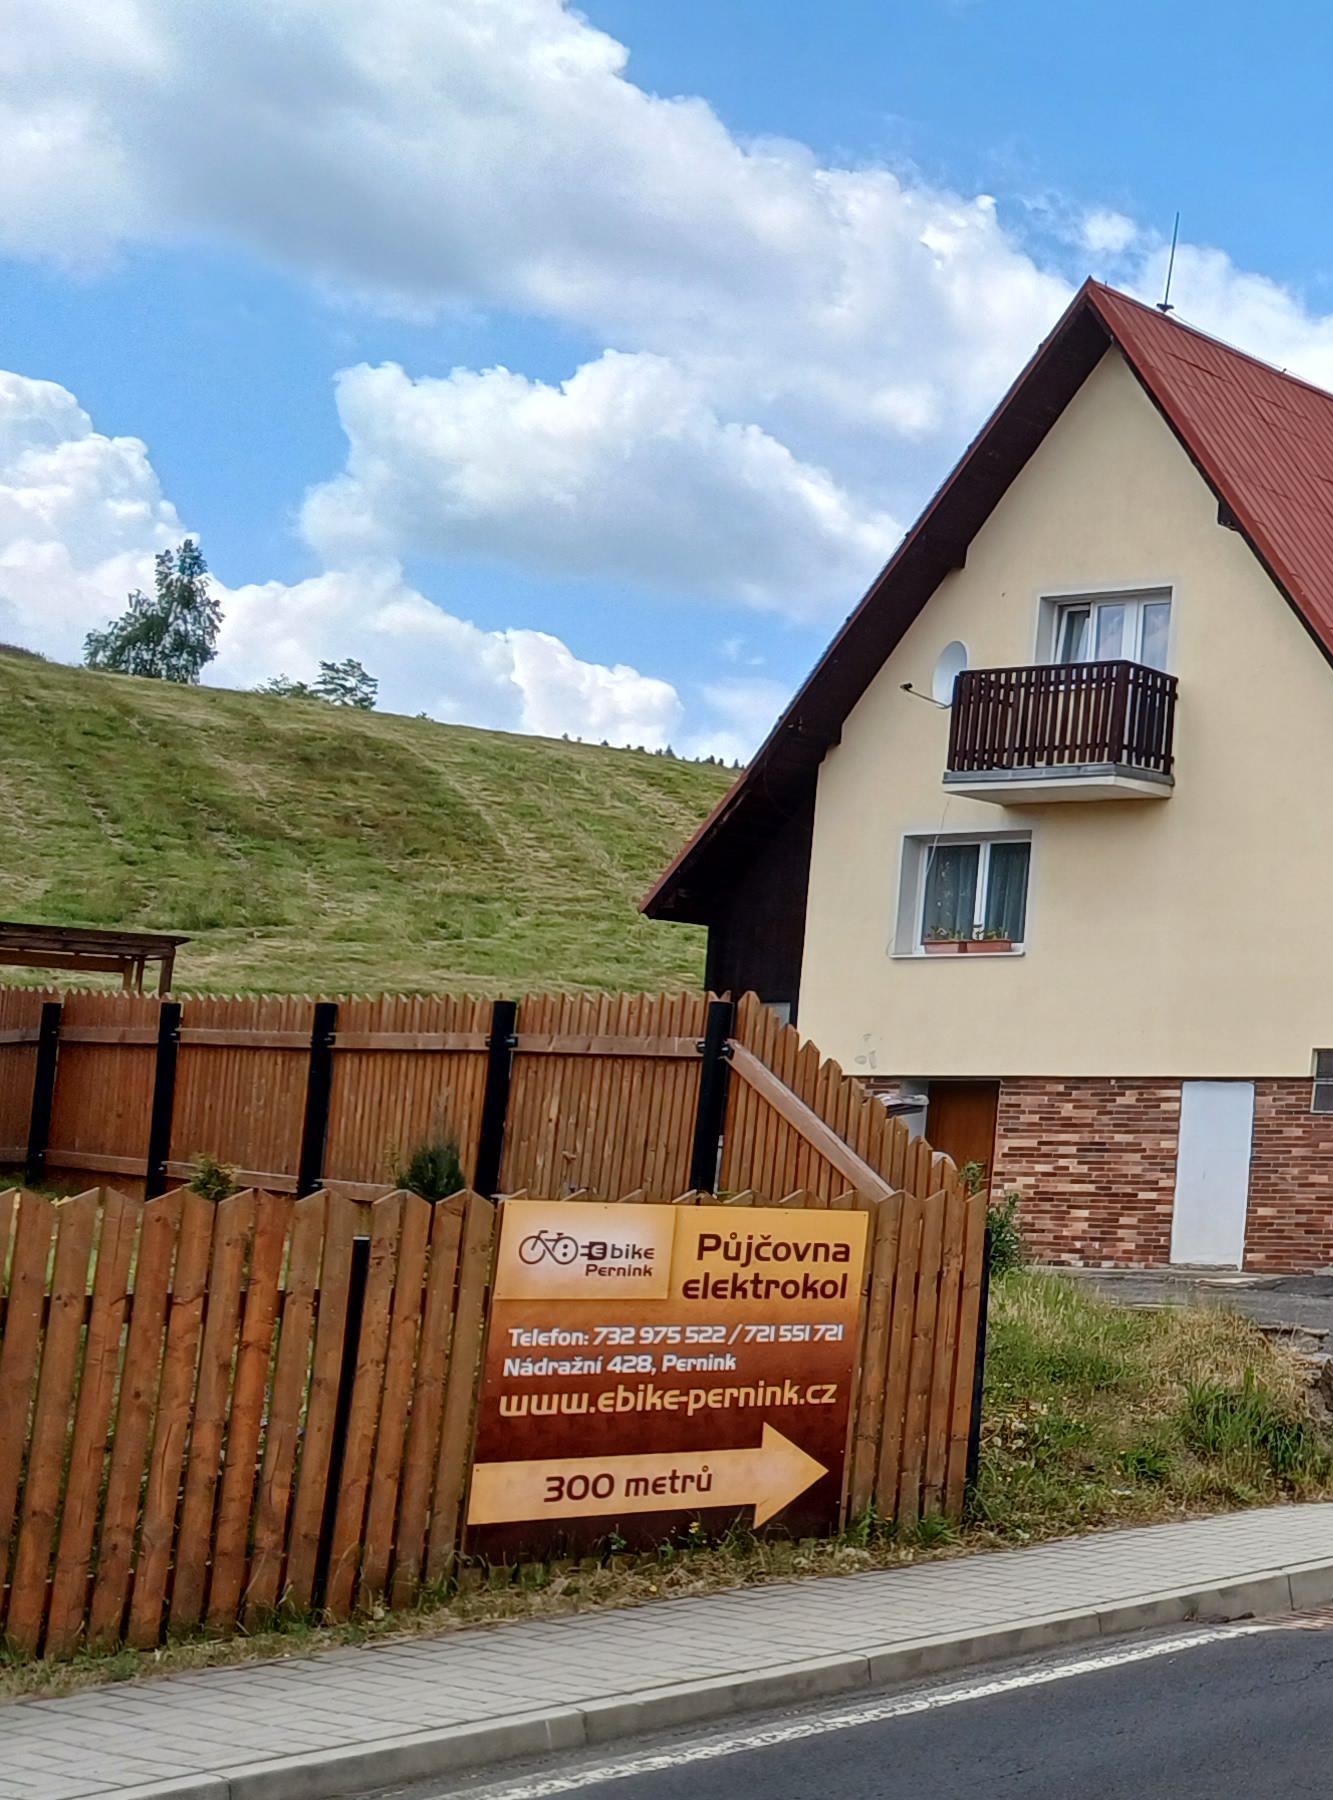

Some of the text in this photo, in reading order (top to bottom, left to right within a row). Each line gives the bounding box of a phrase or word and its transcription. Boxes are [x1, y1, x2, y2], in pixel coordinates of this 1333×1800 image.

[697, 1232, 851, 1268] Půjčovna
[585, 1264, 653, 1277] Pernink
[683, 1272, 847, 1300] elektrokol
[508, 1328, 590, 1347] Telefon:
[593, 1326, 636, 1346] 732
[639, 1326, 681, 1345] 975
[684, 1326, 726, 1344] 522
[744, 1324, 775, 1343] 721
[778, 1324, 810, 1342] 551
[813, 1323, 843, 1342] 721
[503, 1352, 737, 1377] Nádražní 428, Pernink
[500, 1379, 838, 1417] www.ebike-pernink.cz
[543, 1465, 713, 1503] 300 metrů
